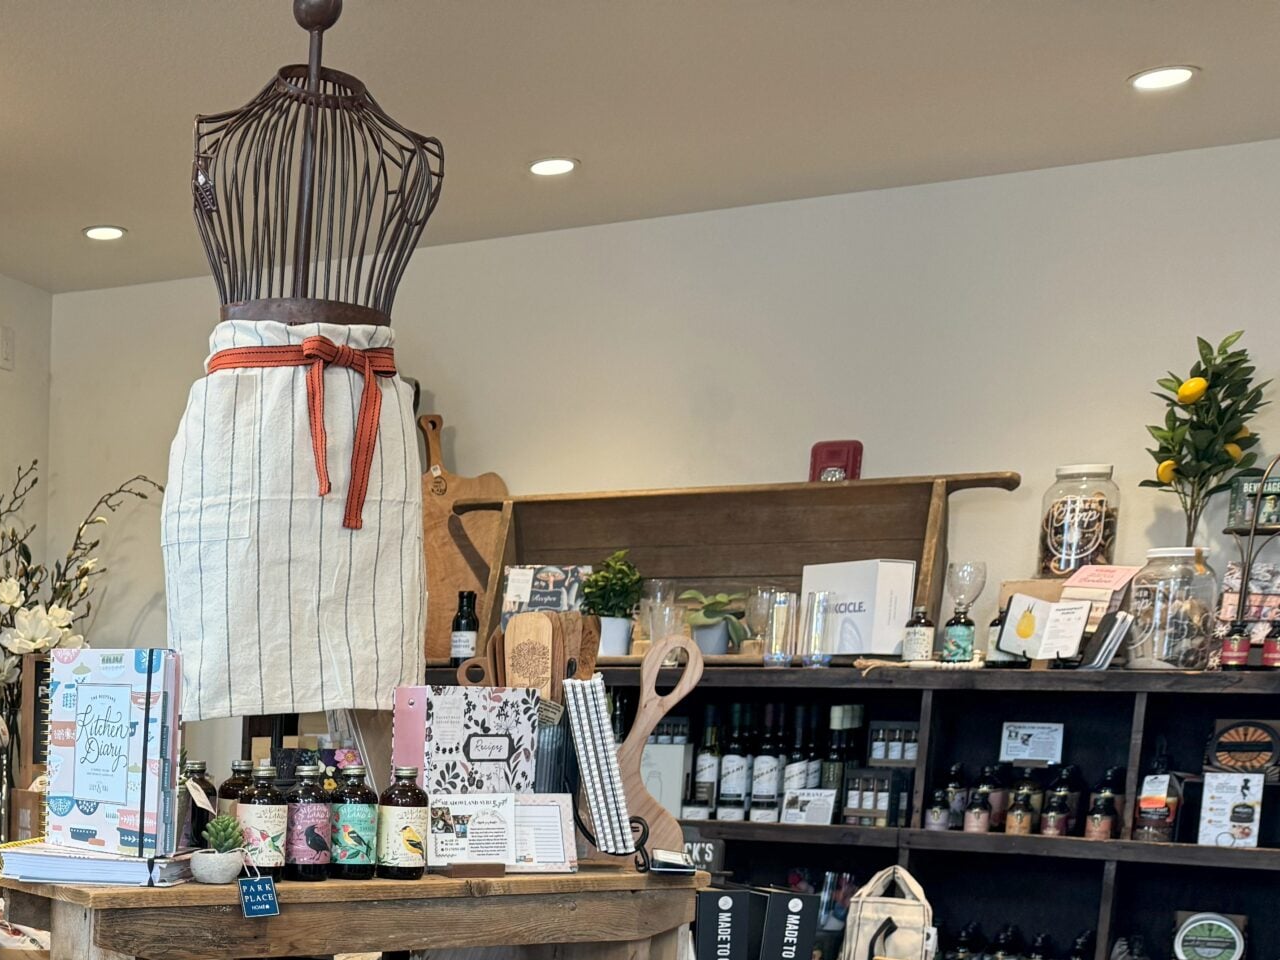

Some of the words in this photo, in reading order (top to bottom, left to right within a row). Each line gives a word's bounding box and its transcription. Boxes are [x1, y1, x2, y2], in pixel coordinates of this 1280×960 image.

[76, 704, 130, 741] Kitchen
[80, 737, 128, 772] Diary
[472, 738, 503, 756] Recipes
[242, 882, 272, 893] PARK
[244, 893, 274, 903] PLACE
[718, 912, 731, 938] MADE
[785, 914, 800, 942] MADE
[718, 941, 730, 956] TO
[782, 944, 797, 960] TO
